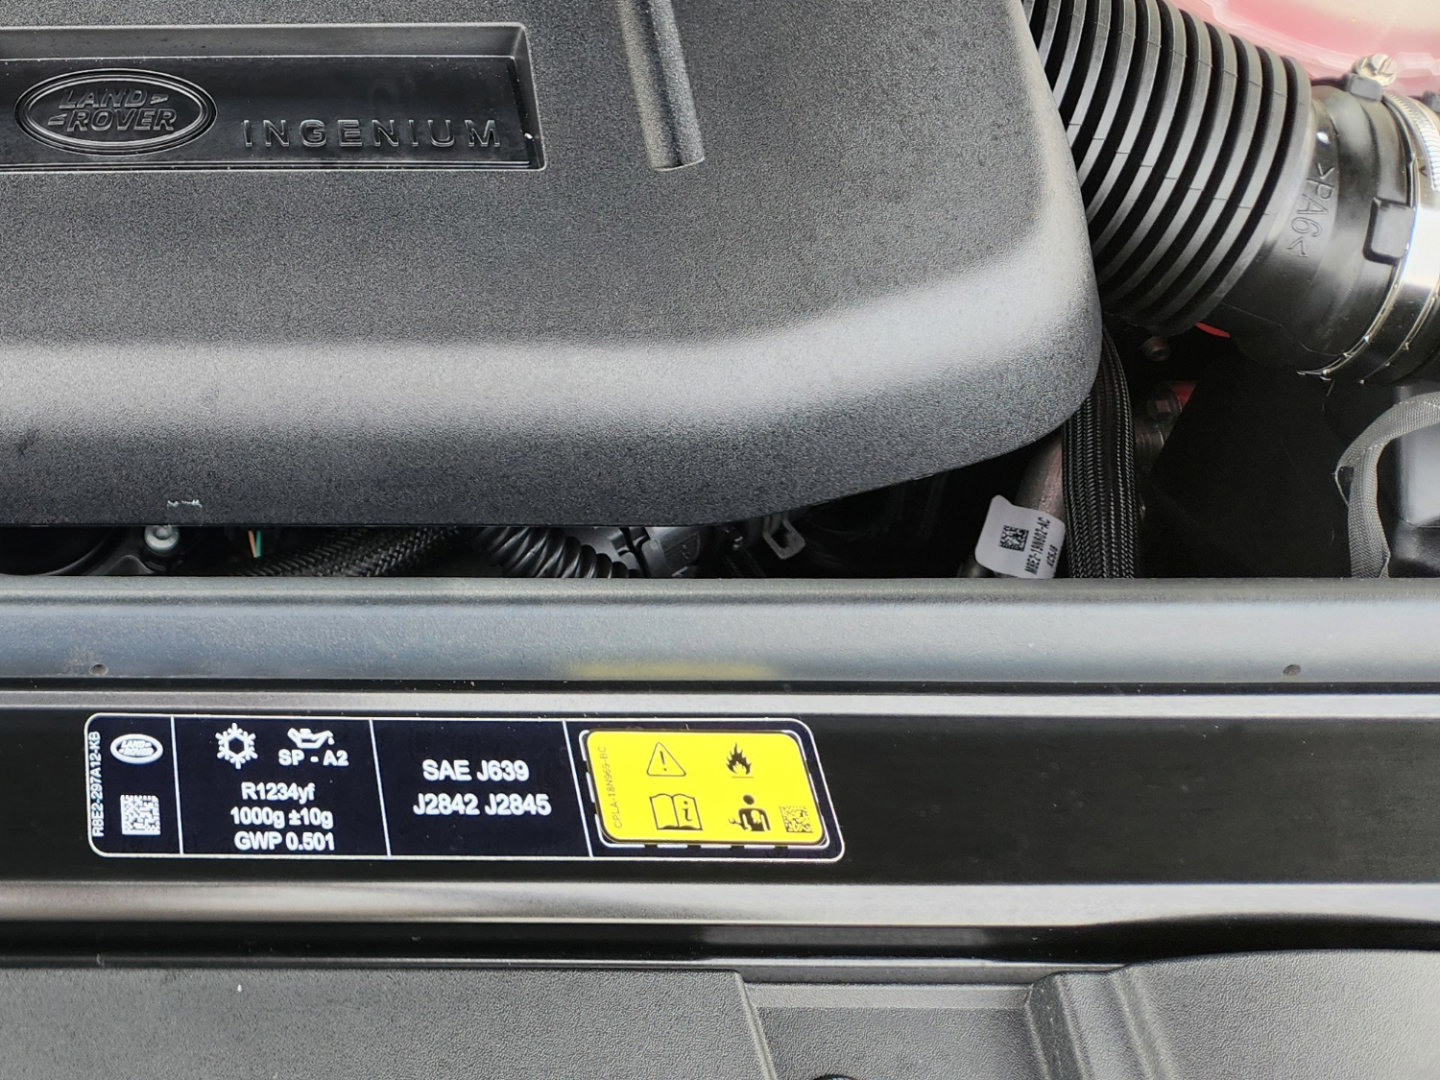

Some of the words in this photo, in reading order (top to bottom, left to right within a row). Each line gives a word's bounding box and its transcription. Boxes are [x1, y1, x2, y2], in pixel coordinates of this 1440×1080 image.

[58, 89, 148, 109] LAND
[67, 108, 176, 132] ROVER
[243, 118, 502, 148] INGENIUM
[278, 749, 303, 767] SP
[323, 749, 349, 767] A2
[422, 759, 472, 781] SAE
[477, 759, 530, 782] J639
[241, 782, 315, 804] R1234yf
[413, 793, 480, 815] J2842
[484, 793, 551, 816] J2845
[230, 806, 285, 828] 1000g
[288, 808, 334, 829] ±10g
[234, 832, 282, 851] GWP
[286, 831, 335, 851] 0.501
